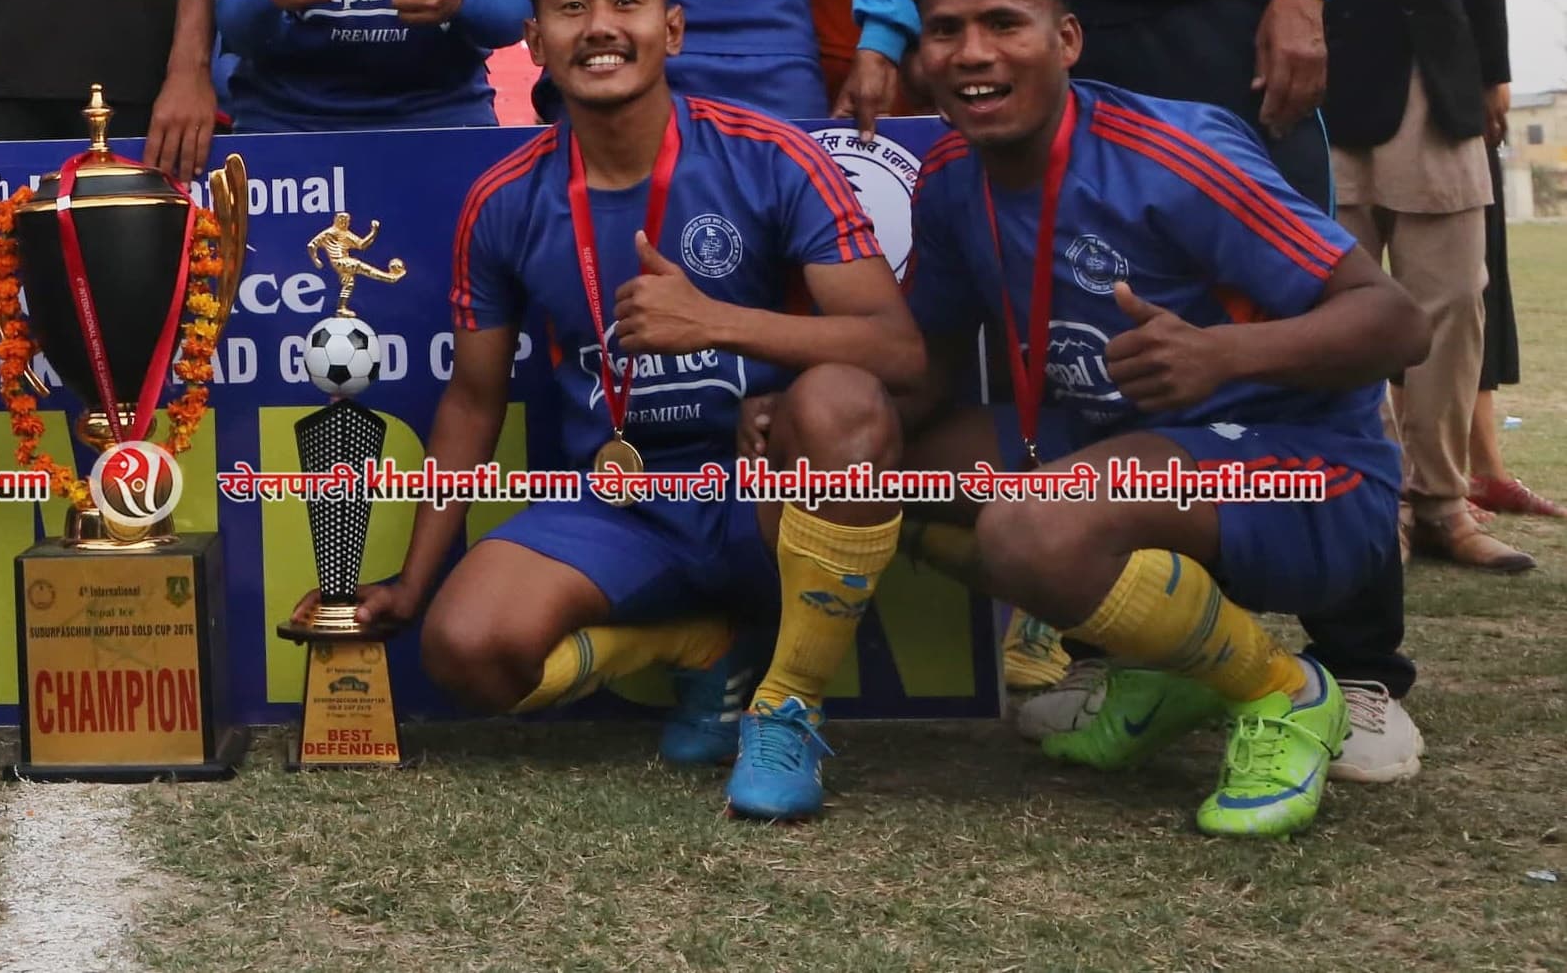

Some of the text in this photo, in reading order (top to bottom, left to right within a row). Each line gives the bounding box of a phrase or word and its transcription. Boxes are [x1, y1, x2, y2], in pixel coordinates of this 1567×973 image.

[331, 27, 409, 42] PREMIUM
[231, 271, 326, 315] ce
[89, 585, 141, 597] International
[132, 624, 152, 637] GOLD
[155, 624, 171, 636] CUP
[35, 667, 200, 735] CHAMPION
[328, 729, 372, 742] BEST
[304, 743, 396, 756] DEFENDER
